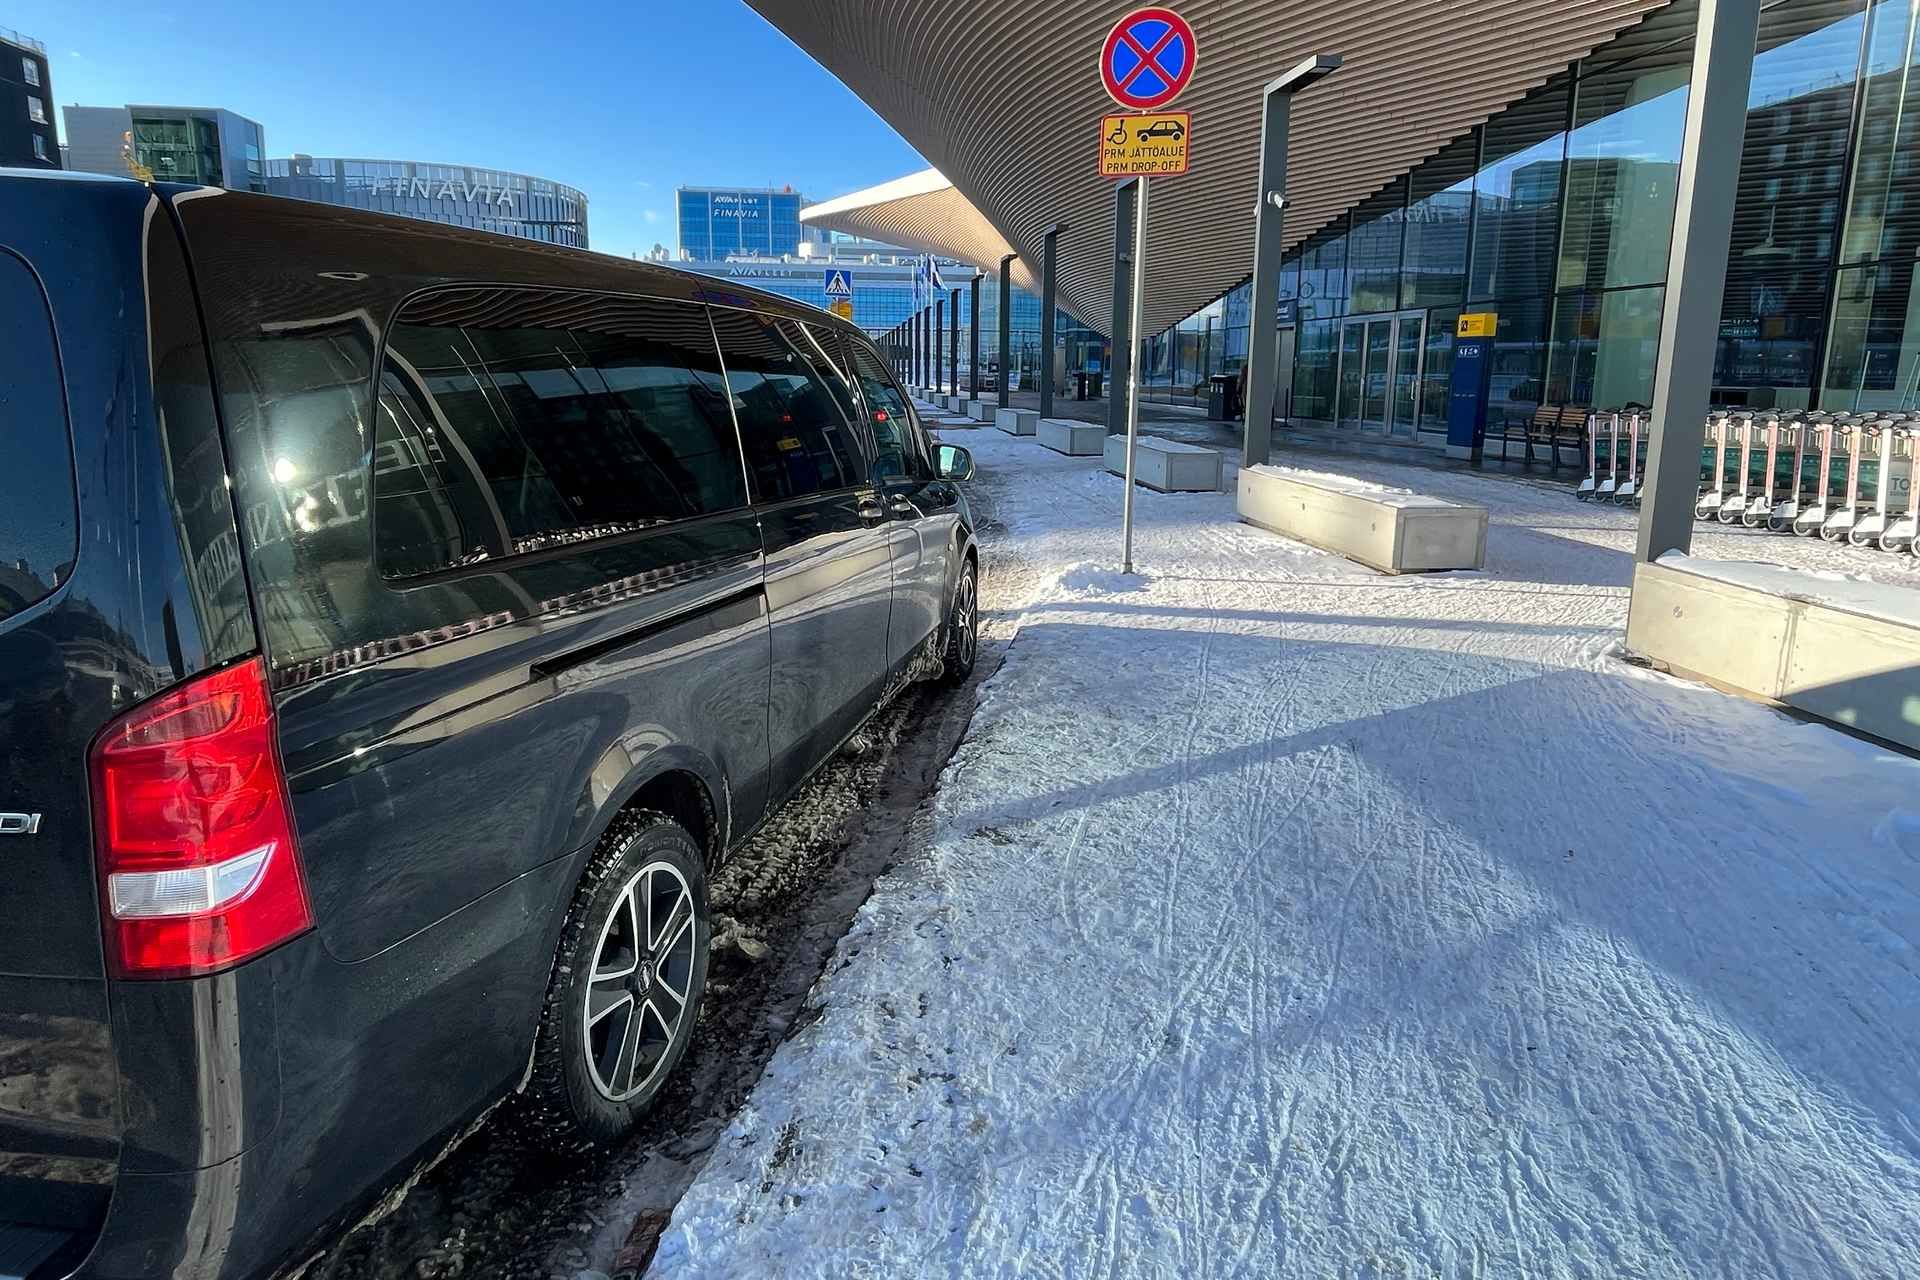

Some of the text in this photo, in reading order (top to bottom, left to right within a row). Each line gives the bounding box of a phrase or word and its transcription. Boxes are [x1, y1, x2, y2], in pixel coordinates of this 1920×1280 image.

[1104, 148, 1126, 158] PRM
[1106, 160, 1181, 172] PRM DROP-OFF
[371, 175, 514, 208] FINAVIA
[713, 208, 759, 218] FINAVIA
